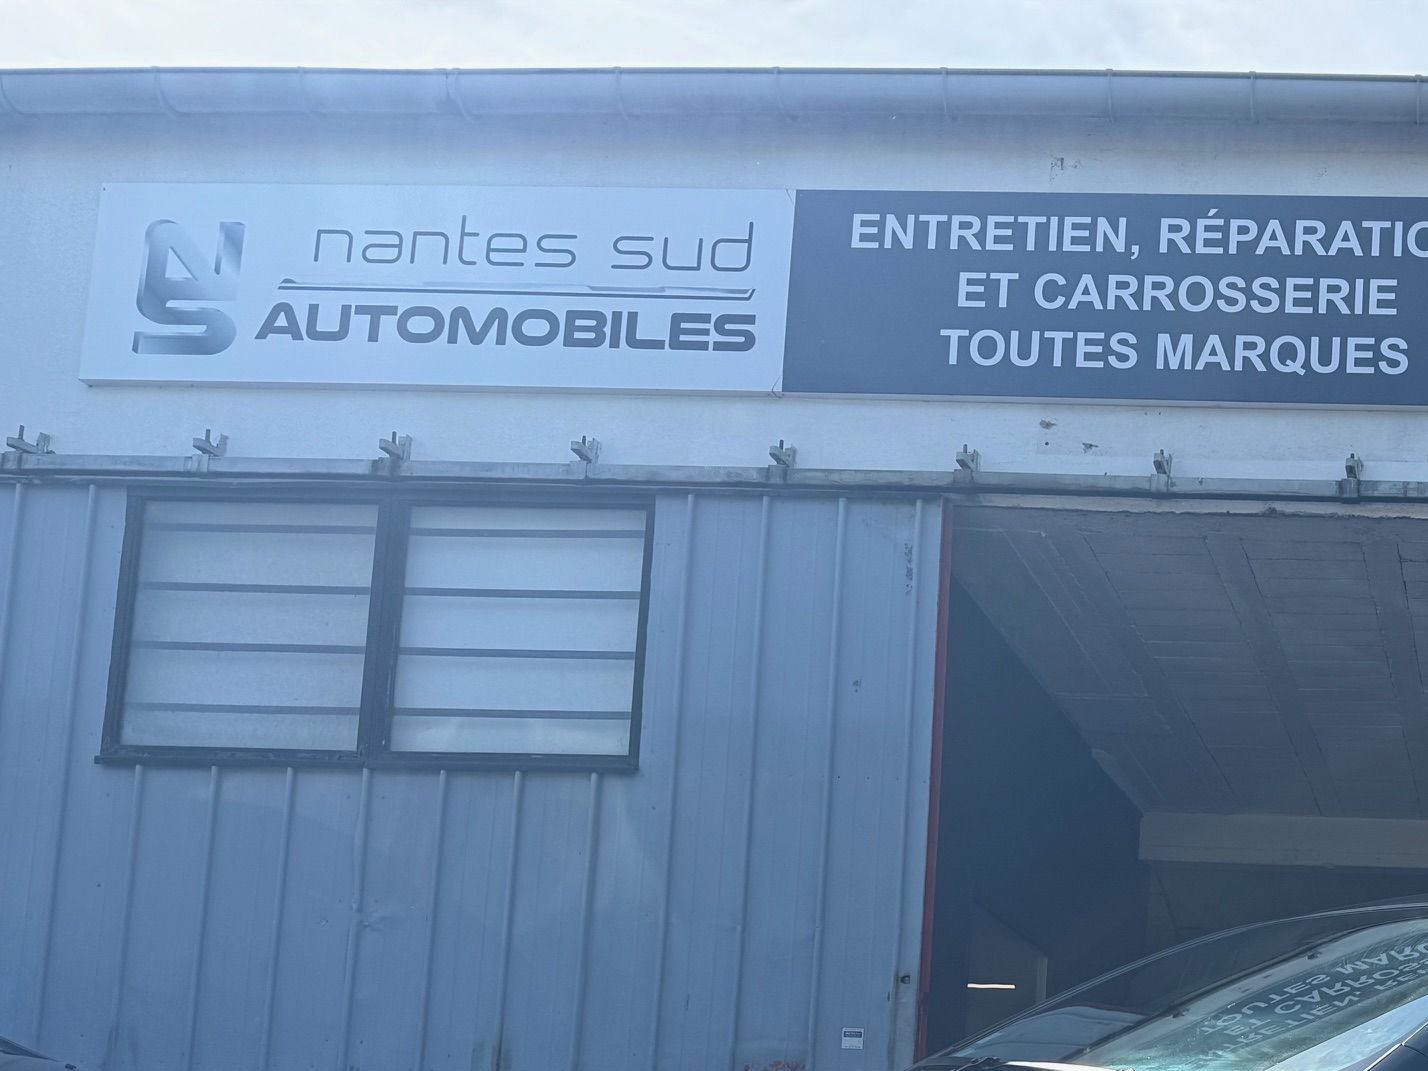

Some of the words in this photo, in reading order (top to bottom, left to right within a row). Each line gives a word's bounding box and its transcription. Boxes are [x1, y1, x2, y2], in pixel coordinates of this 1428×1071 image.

[313, 214, 578, 270] nantes
[610, 220, 755, 273] sud
[849, 212, 1142, 260] ENTRETIEN,
[956, 271, 1019, 308] ET
[1033, 273, 1399, 316] CARROSSERIE
[254, 301, 757, 352] AUTOMOBILES
[939, 328, 1138, 369] TOUTES
[1155, 333, 1410, 376] MARQUES
